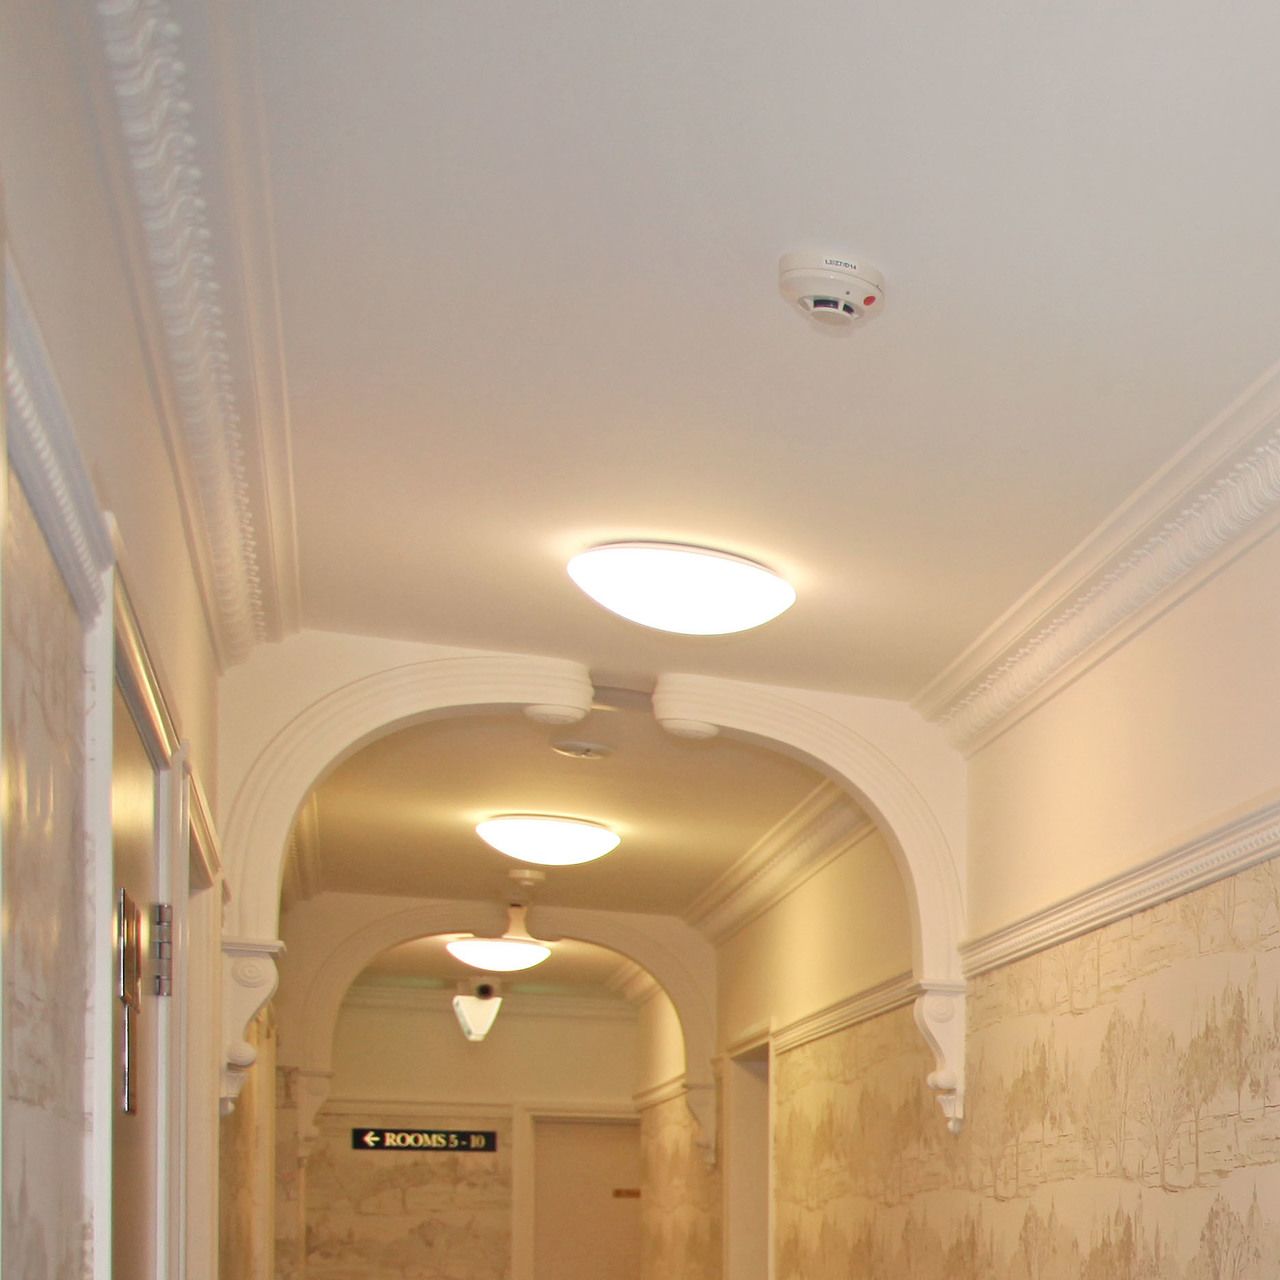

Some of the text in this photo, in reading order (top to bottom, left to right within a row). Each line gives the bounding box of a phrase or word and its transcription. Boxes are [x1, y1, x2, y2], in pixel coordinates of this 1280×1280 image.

[384, 1132, 447, 1148] ROOMS
[448, 1134, 458, 1148] 5
[470, 1134, 486, 1149] 10
